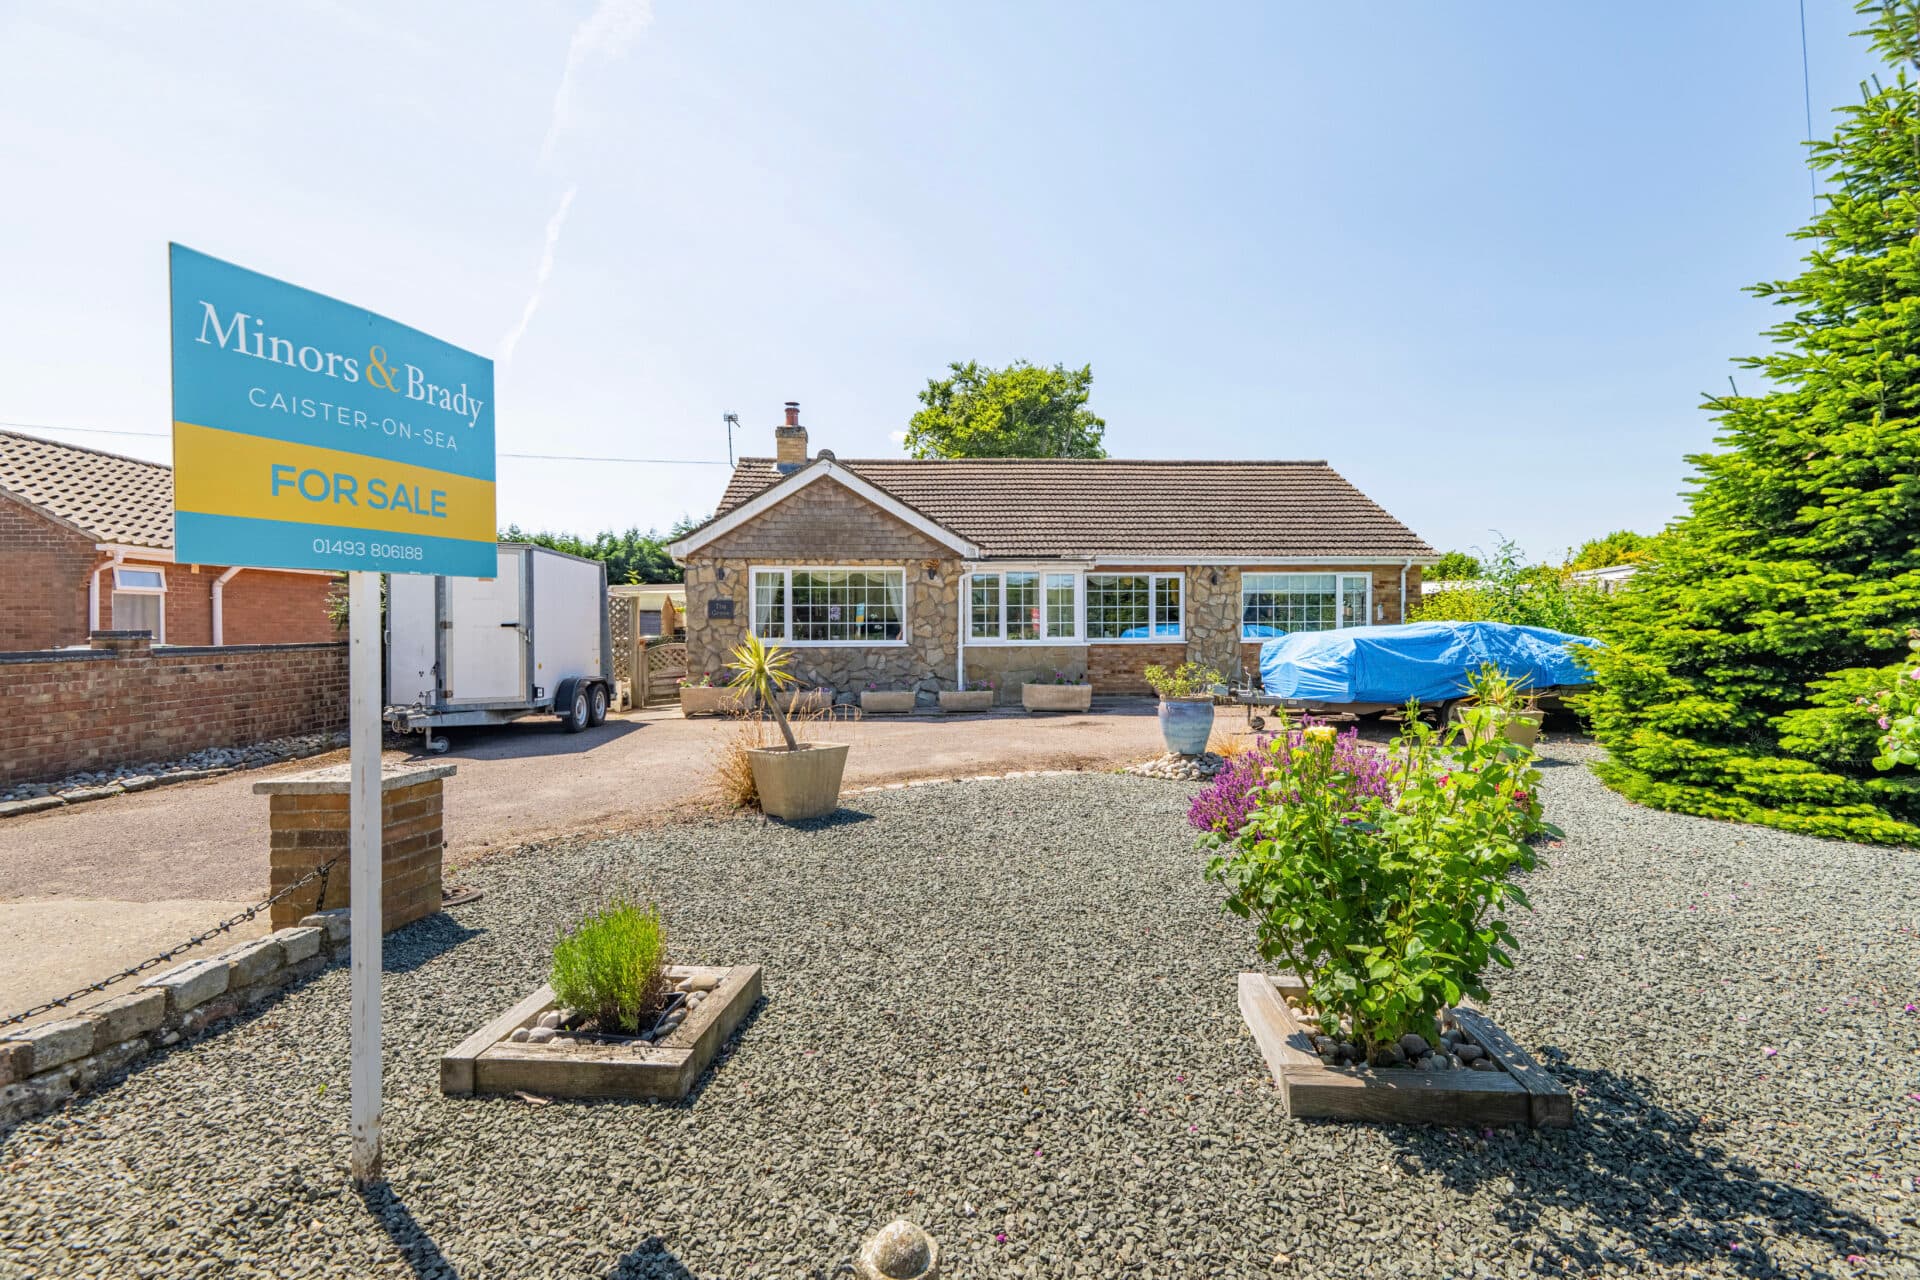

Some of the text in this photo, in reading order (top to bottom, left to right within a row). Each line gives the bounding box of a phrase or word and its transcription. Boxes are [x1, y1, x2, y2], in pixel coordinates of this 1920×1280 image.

[195, 300, 484, 427] Minors & Brady
[249, 387, 457, 451] CAISTER-ON-SEA
[271, 463, 447, 518] FOR SALE
[313, 538, 423, 560] 01493 806188
